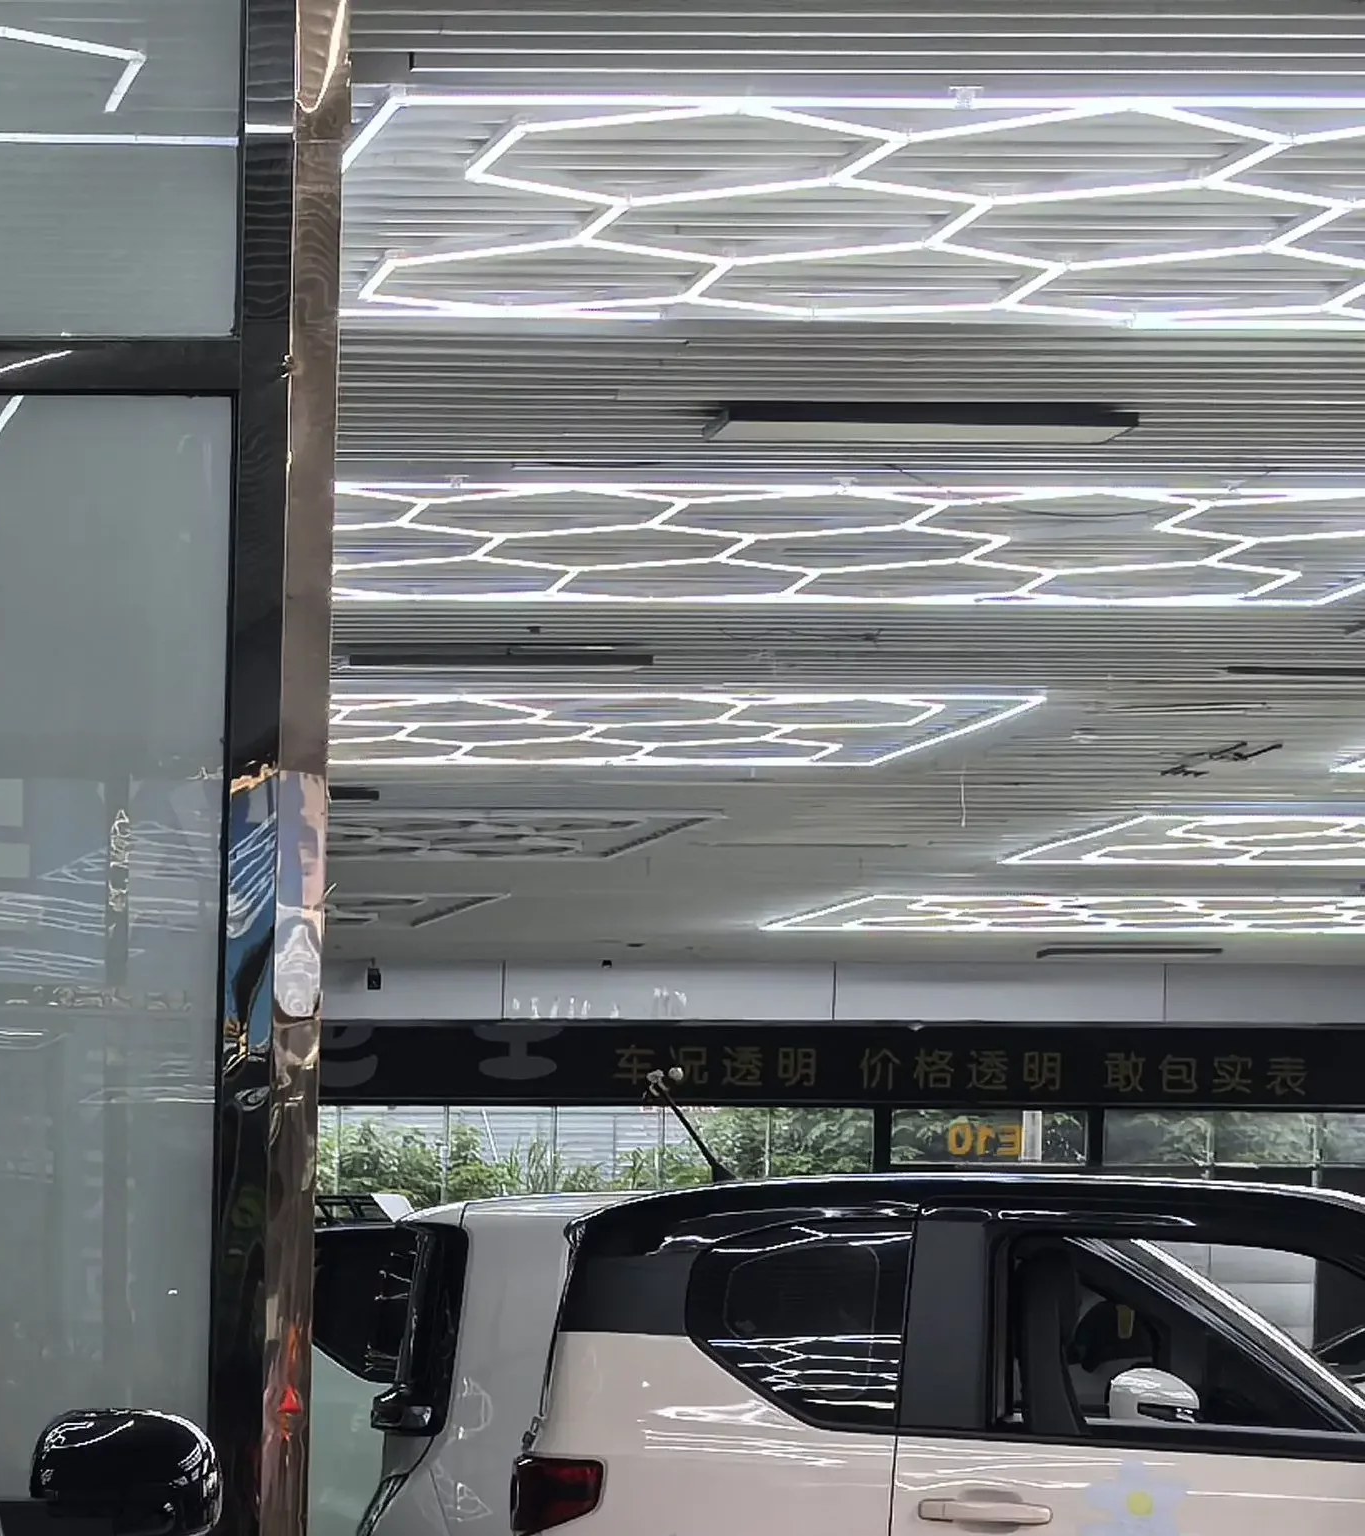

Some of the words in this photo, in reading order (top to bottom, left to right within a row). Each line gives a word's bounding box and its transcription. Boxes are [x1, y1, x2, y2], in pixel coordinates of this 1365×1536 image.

[614, 1045, 817, 1087] 车况透明
[859, 1047, 1062, 1091] 价格透明
[1104, 1051, 1309, 1096] 敢包实表
